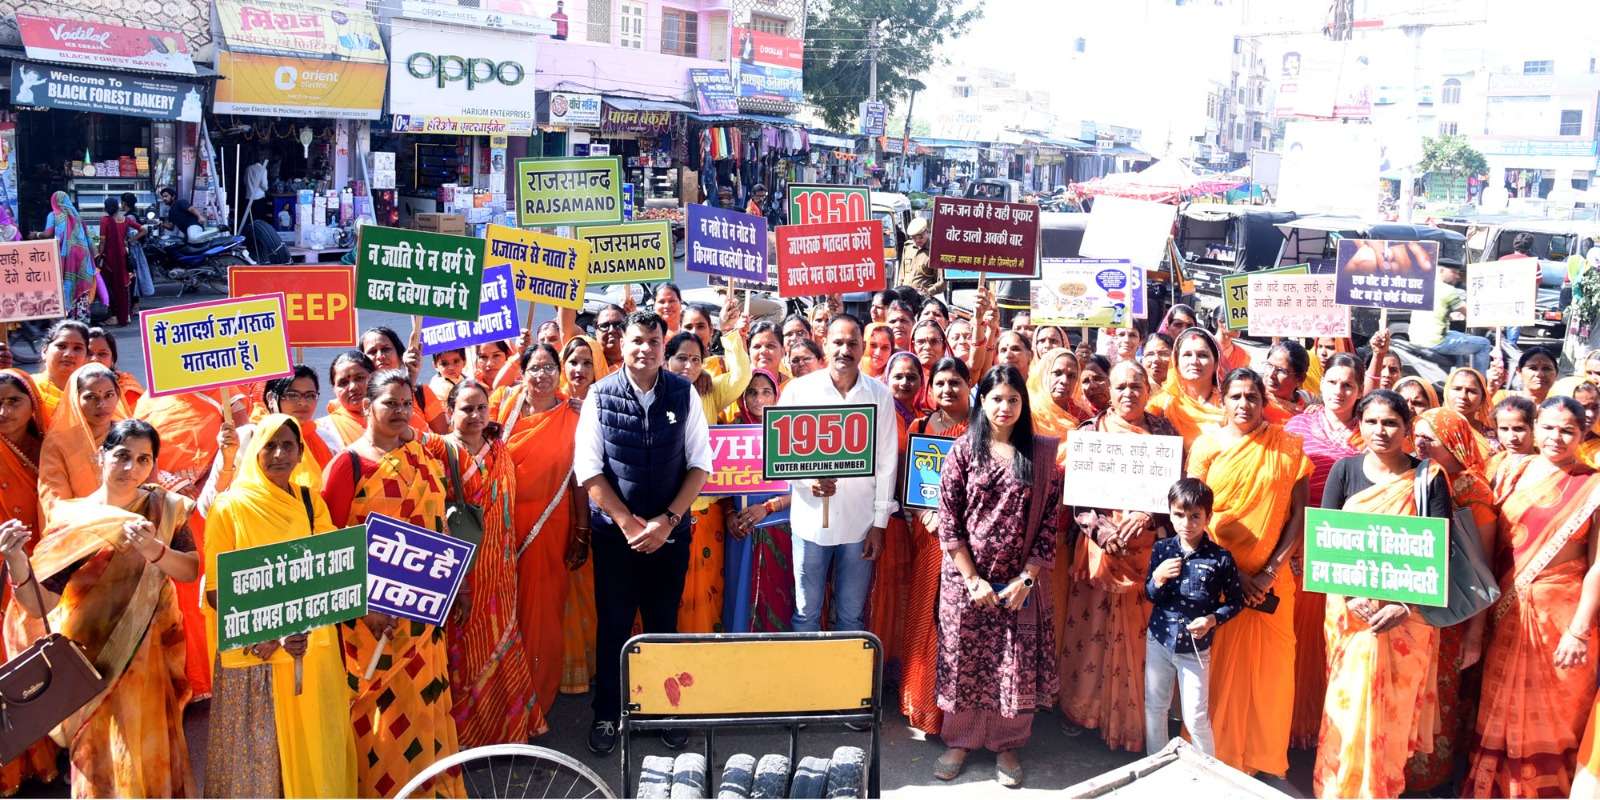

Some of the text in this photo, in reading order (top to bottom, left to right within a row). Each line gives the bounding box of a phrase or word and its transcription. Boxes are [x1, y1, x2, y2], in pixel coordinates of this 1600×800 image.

[50, 23, 111, 48] Vadilal
[50, 71, 105, 86] Welcome
[108, 79, 123, 88] To
[302, 70, 338, 82] orient
[408, 52, 525, 91] oppo
[48, 82, 175, 110] BLACK FOREST BAKERY
[461, 107, 531, 119] HARIOM ENTERPRISES
[526, 170, 611, 191] राजसमन्द
[525, 196, 617, 215] RAJSAMAND
[794, 191, 866, 225] 1950
[939, 202, 1034, 226] जन-जन की है यही पुकार
[700, 218, 708, 237] न
[708, 216, 721, 239] नशे
[722, 217, 729, 240] से
[730, 223, 736, 241] न
[737, 221, 749, 244] नोट
[822, 232, 851, 254] मतदान
[945, 225, 1024, 247] वोट डालो अबकी बार
[368, 241, 477, 276] न जाति पे न धर्म पे
[531, 241, 541, 264] से
[543, 248, 568, 269] नाता
[569, 247, 578, 271] है
[718, 246, 744, 270] बदलेगी
[744, 249, 756, 272] वोट
[756, 251, 763, 274] से
[516, 269, 581, 302] के मतदाता हैं
[788, 261, 856, 287] अपने मन का राज
[367, 276, 470, 310] बटन दबेगा कर्म पे
[153, 320, 173, 346] मैं
[171, 314, 216, 345] आदर्श
[181, 347, 238, 373] मतदाता
[771, 411, 870, 457] 1950
[709, 436, 763, 461] VH
[774, 460, 866, 472] VOTER HELPLINE NUMBER
[1366, 524, 1380, 553] में
[368, 531, 461, 580] वोट है
[231, 546, 356, 596] बहकावे में कभी न आना
[1311, 559, 1440, 596] हम सबकी है जिम्मेदारी
[367, 573, 448, 617] ाकत
[223, 583, 364, 640] सोच समझ कर बटन दबाना
